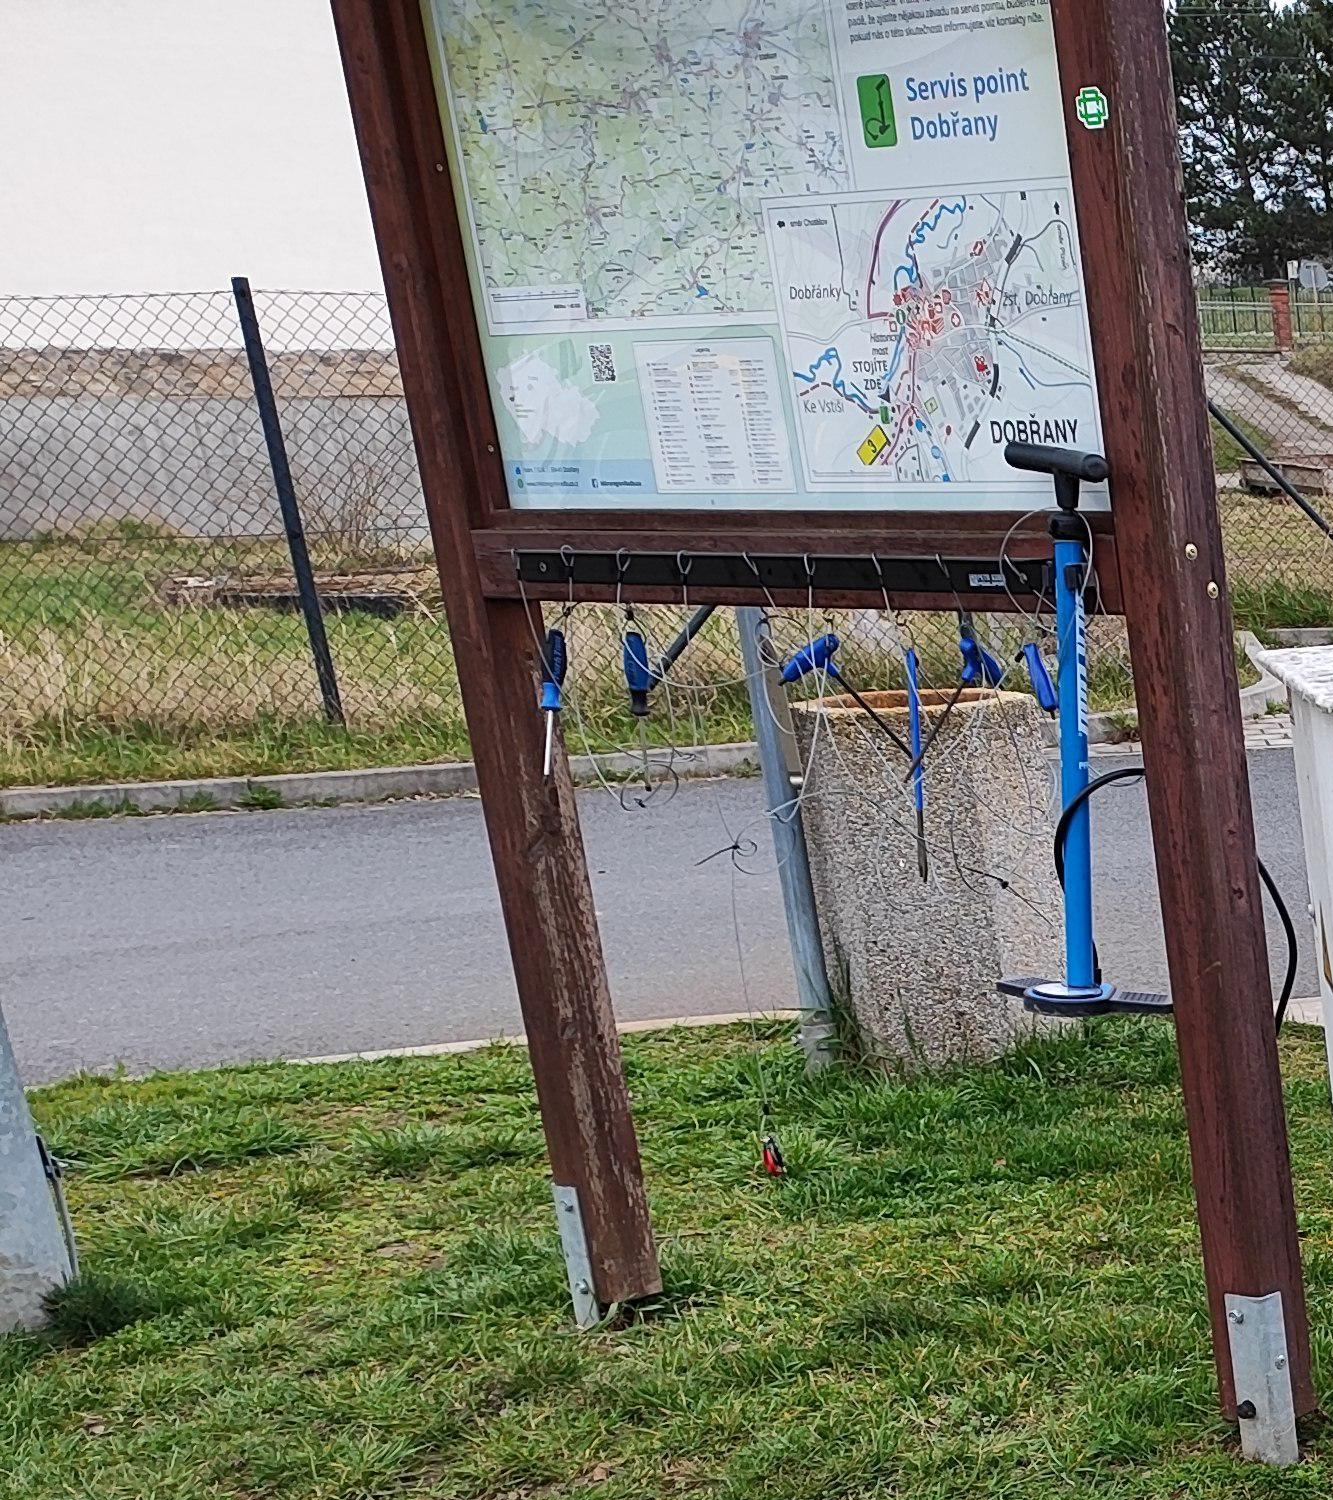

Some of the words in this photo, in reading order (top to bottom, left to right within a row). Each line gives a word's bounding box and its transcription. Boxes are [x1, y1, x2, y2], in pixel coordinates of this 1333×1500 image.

[905, 72, 968, 102] Servis
[973, 67, 1030, 103] point
[910, 111, 999, 142] Dobřany
[789, 284, 842, 301] Dobřánky
[852, 357, 888, 375] STOJÍTE
[864, 379, 882, 390] ZDE
[804, 400, 817, 413] Ke
[990, 412, 1078, 443] DOBŘANY
[867, 439, 878, 453] 3
